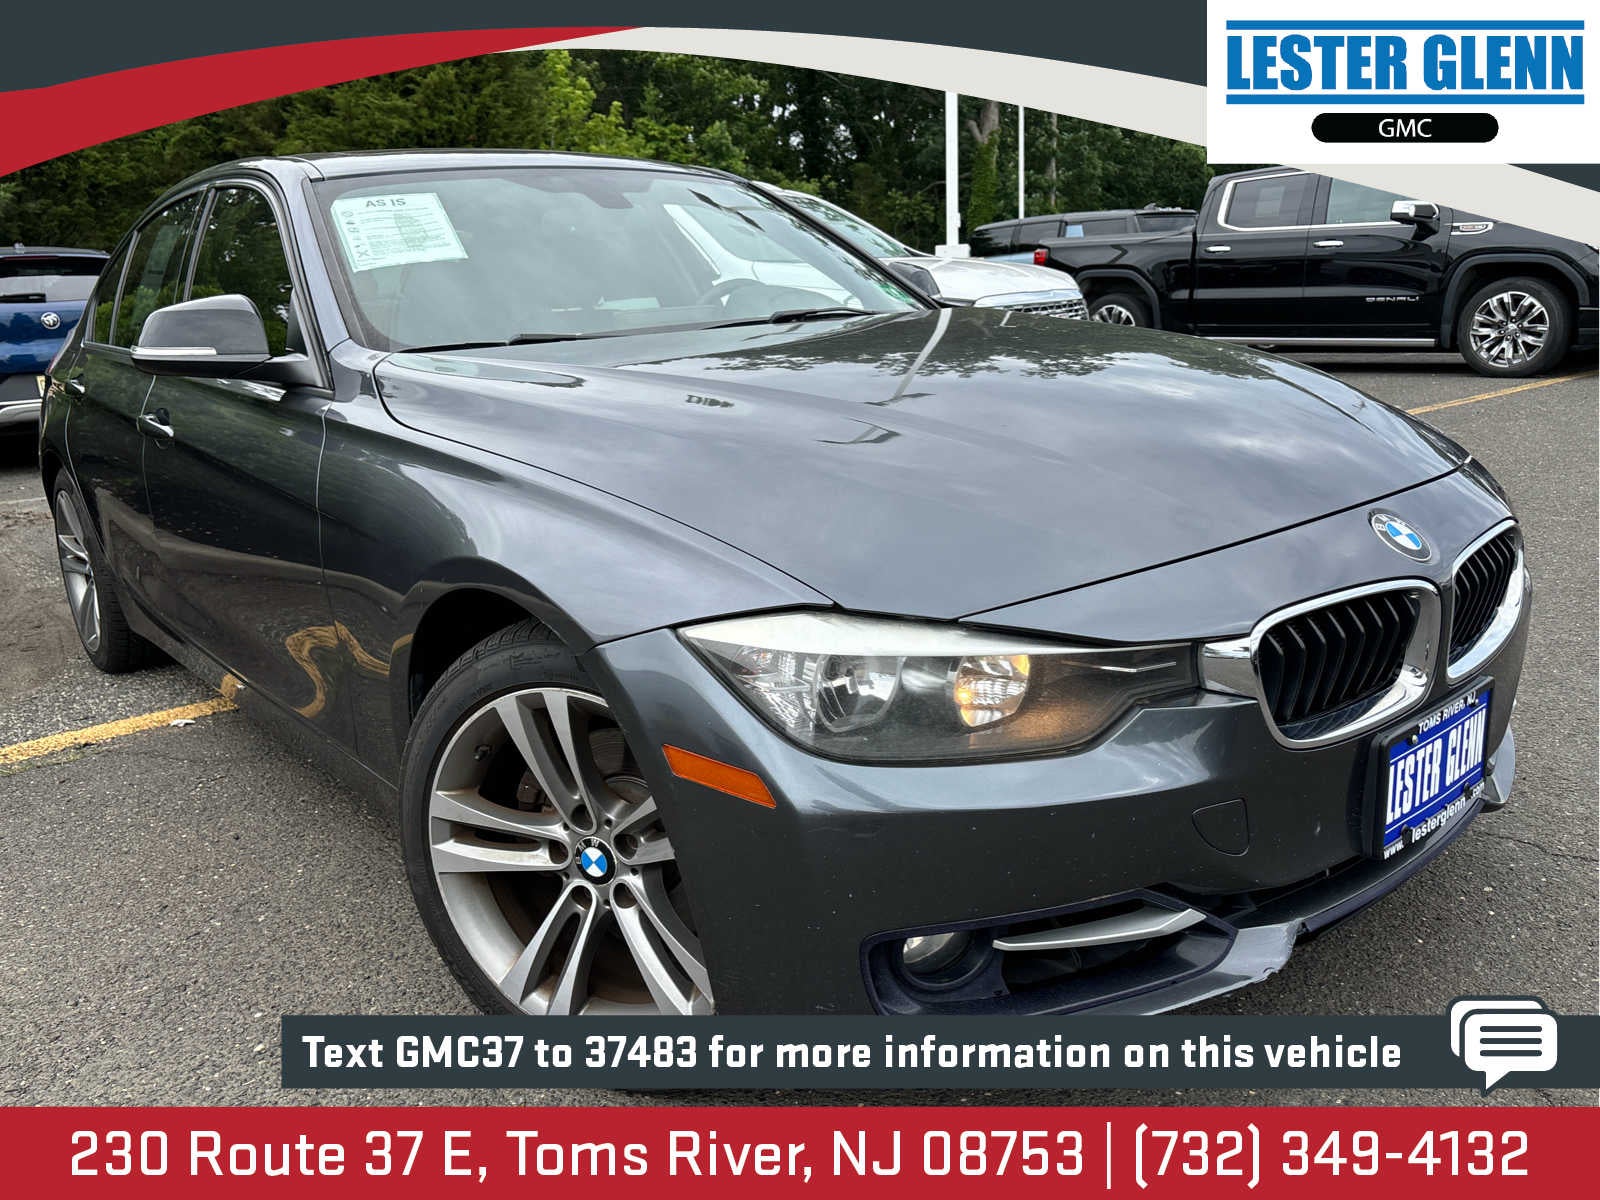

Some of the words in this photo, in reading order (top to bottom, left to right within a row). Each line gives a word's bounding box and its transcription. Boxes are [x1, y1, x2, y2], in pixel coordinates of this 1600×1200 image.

[365, 199, 387, 208] AS
[391, 198, 407, 207] IS
[1418, 713, 1442, 734] TOMS
[1385, 738, 1443, 826] LESTER
[1445, 708, 1487, 787] GLENN
